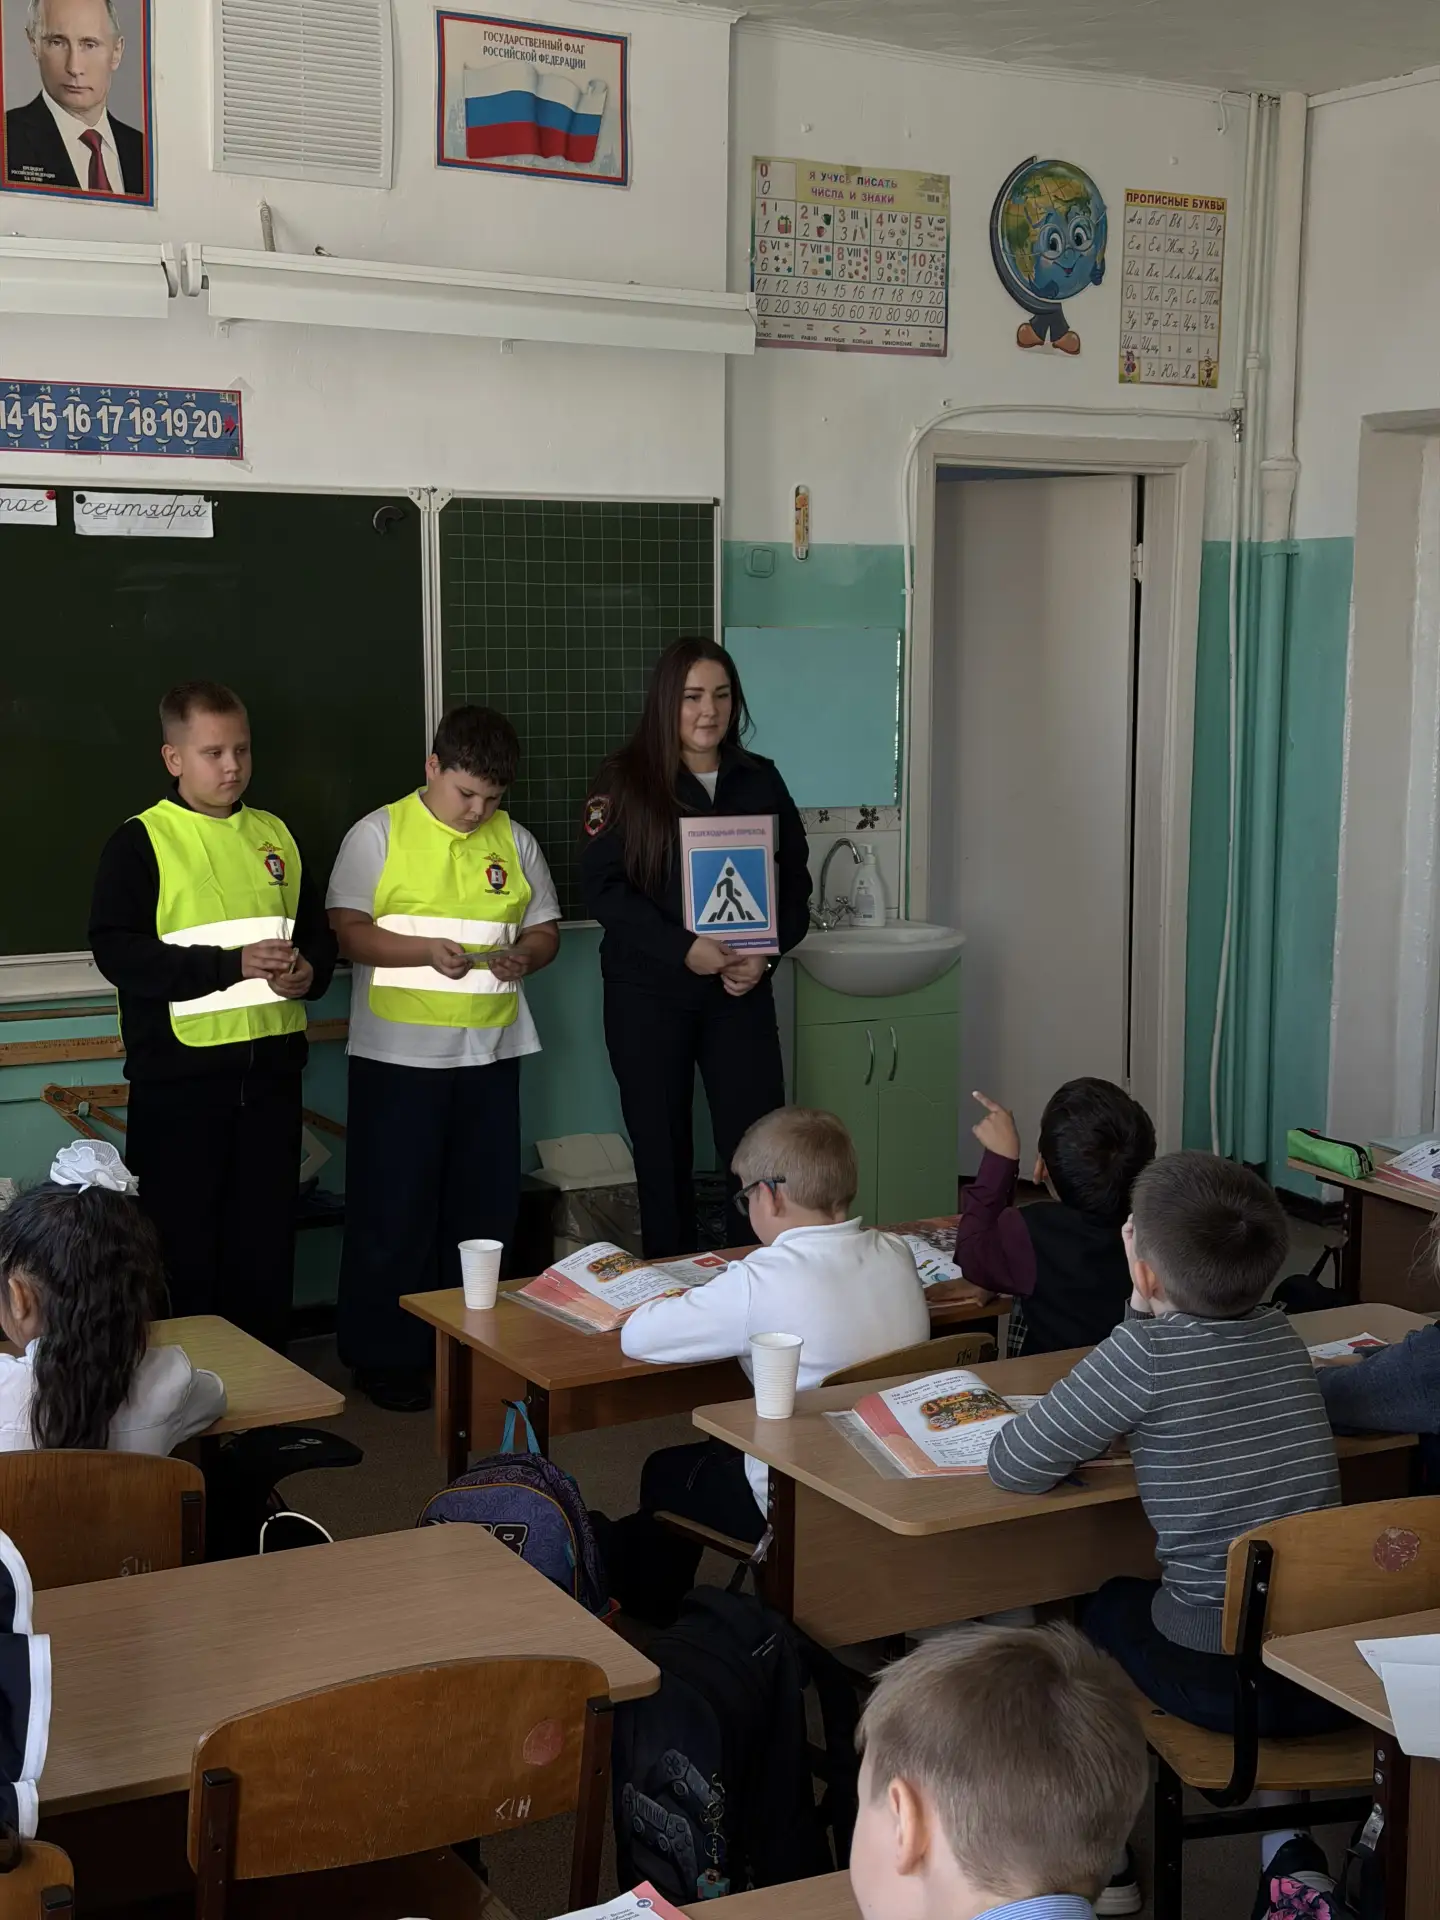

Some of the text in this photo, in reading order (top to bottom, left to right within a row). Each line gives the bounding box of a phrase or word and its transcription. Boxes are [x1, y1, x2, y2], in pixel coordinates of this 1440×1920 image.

[483, 30, 586, 55] ГОСУДАРСТВЕННЫЙ ФЛАГ
[483, 46, 586, 70] РОССИЙСКОЙ ФЕДЕРАЦИИ
[760, 163, 768, 177] 0
[809, 171, 898, 188] Я УЧУСЬ ПИСАТЬ
[762, 180, 771, 195] 0
[811, 188, 895, 204] ЧИСЛА И ЗНАКИ
[1126, 192, 1224, 210] ПРОПИСНЫЕ БУКВЫ
[761, 202, 767, 215] 1
[800, 206, 808, 219] 2
[839, 210, 846, 223] 3
[876, 213, 884, 227] 4
[888, 214, 897, 223] IV
[914, 216, 922, 229] 5
[764, 220, 924, 247] 1 2 3 4 5
[759, 240, 767, 253] 6
[771, 241, 780, 250] VI
[800, 243, 807, 257] 7
[810, 244, 822, 254] VII
[837, 247, 844, 261] 8
[847, 248, 861, 257] VIII
[875, 251, 882, 264] 9
[886, 251, 896, 261] IX
[911, 254, 926, 267] 10
[761, 258, 933, 284] 6 7 8 9 10
[756, 278, 943, 305] 11 12 13 14 15 16 17 18 19 20
[756, 298, 944, 324] 10 20 30 40 50 60 70 80 90 100
[28, 402, 57, 432] 15
[63, 403, 91, 433] 16
[96, 405, 124, 435] 17
[129, 407, 157, 436] 18
[161, 408, 188, 437] 19
[193, 410, 222, 438] 20
[81, 495, 207, 529] сентября
